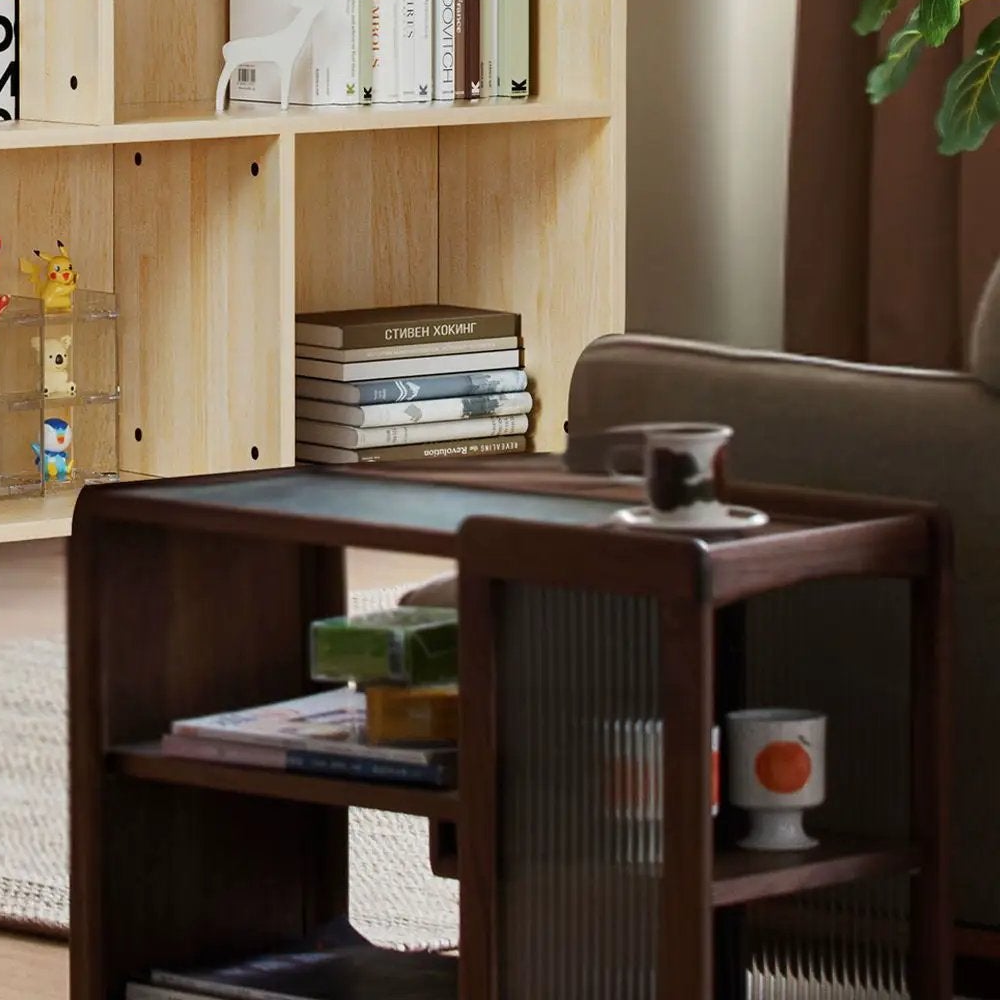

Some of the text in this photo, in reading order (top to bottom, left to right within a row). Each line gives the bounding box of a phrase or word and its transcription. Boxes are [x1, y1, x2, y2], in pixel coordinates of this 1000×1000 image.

[384, 322, 477, 341] СТИВЕН ХОКИНГ
[423, 446, 468, 458] Revolution
[480, 441, 519, 453] REVEALING
